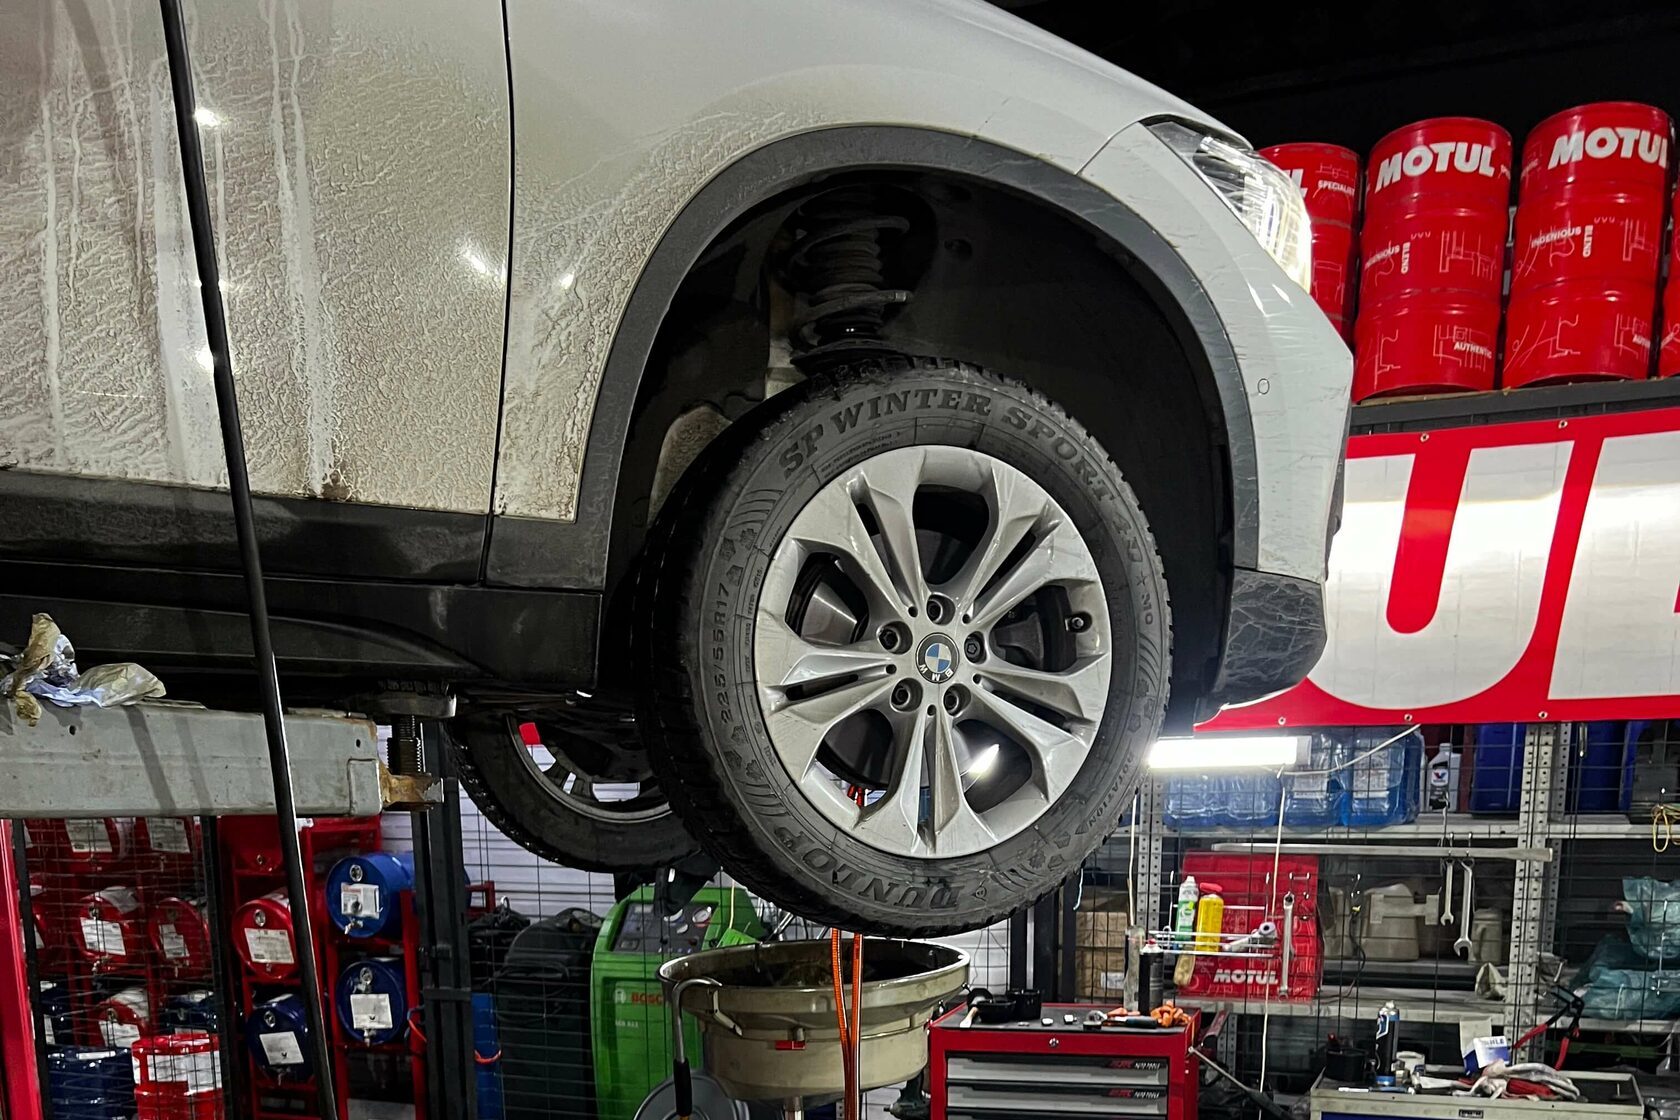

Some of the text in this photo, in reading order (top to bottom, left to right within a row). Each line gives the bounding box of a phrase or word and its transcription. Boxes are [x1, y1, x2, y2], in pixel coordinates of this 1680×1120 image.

[1375, 142, 1496, 194] MOTUL
[778, 423, 824, 481] SP
[830, 388, 992, 434] WINTER
[1001, 406, 1118, 501] SPORT
[712, 582, 734, 725] 225/55R17
[919, 663, 954, 682] BMW
[774, 826, 965, 910] DUNLOP
[1213, 968, 1279, 985] MOTUL
